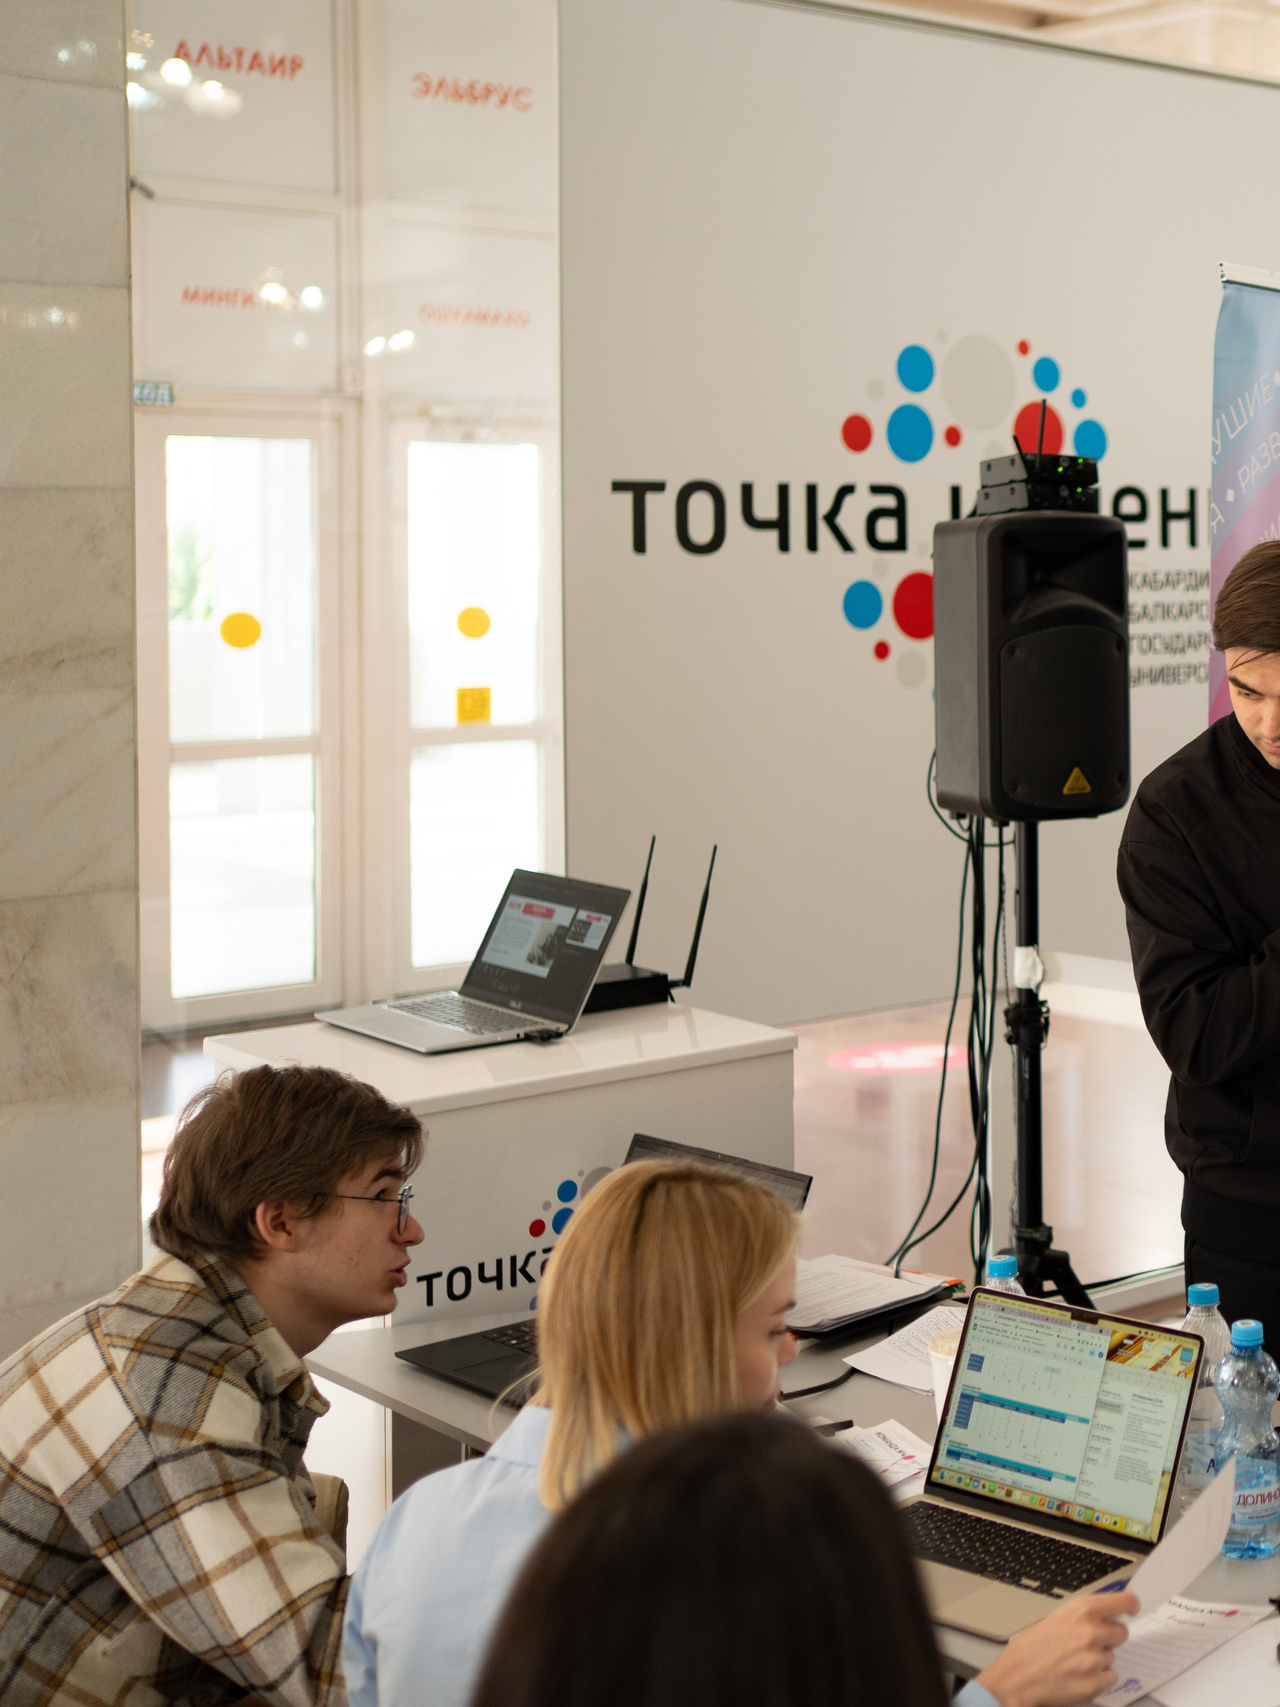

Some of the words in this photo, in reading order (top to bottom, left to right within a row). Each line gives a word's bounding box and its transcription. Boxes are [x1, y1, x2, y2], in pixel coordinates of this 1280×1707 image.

[174, 39, 304, 79] АЛЬТАИР
[411, 73, 533, 111] ЭЛЬБРУС
[1129, 569, 1210, 592] КАБАРДИ
[1129, 602, 1210, 623] БАЛКАРС
[1129, 632, 1210, 655] ГОСУДАР
[1129, 663, 1209, 687] УНИВЕРС
